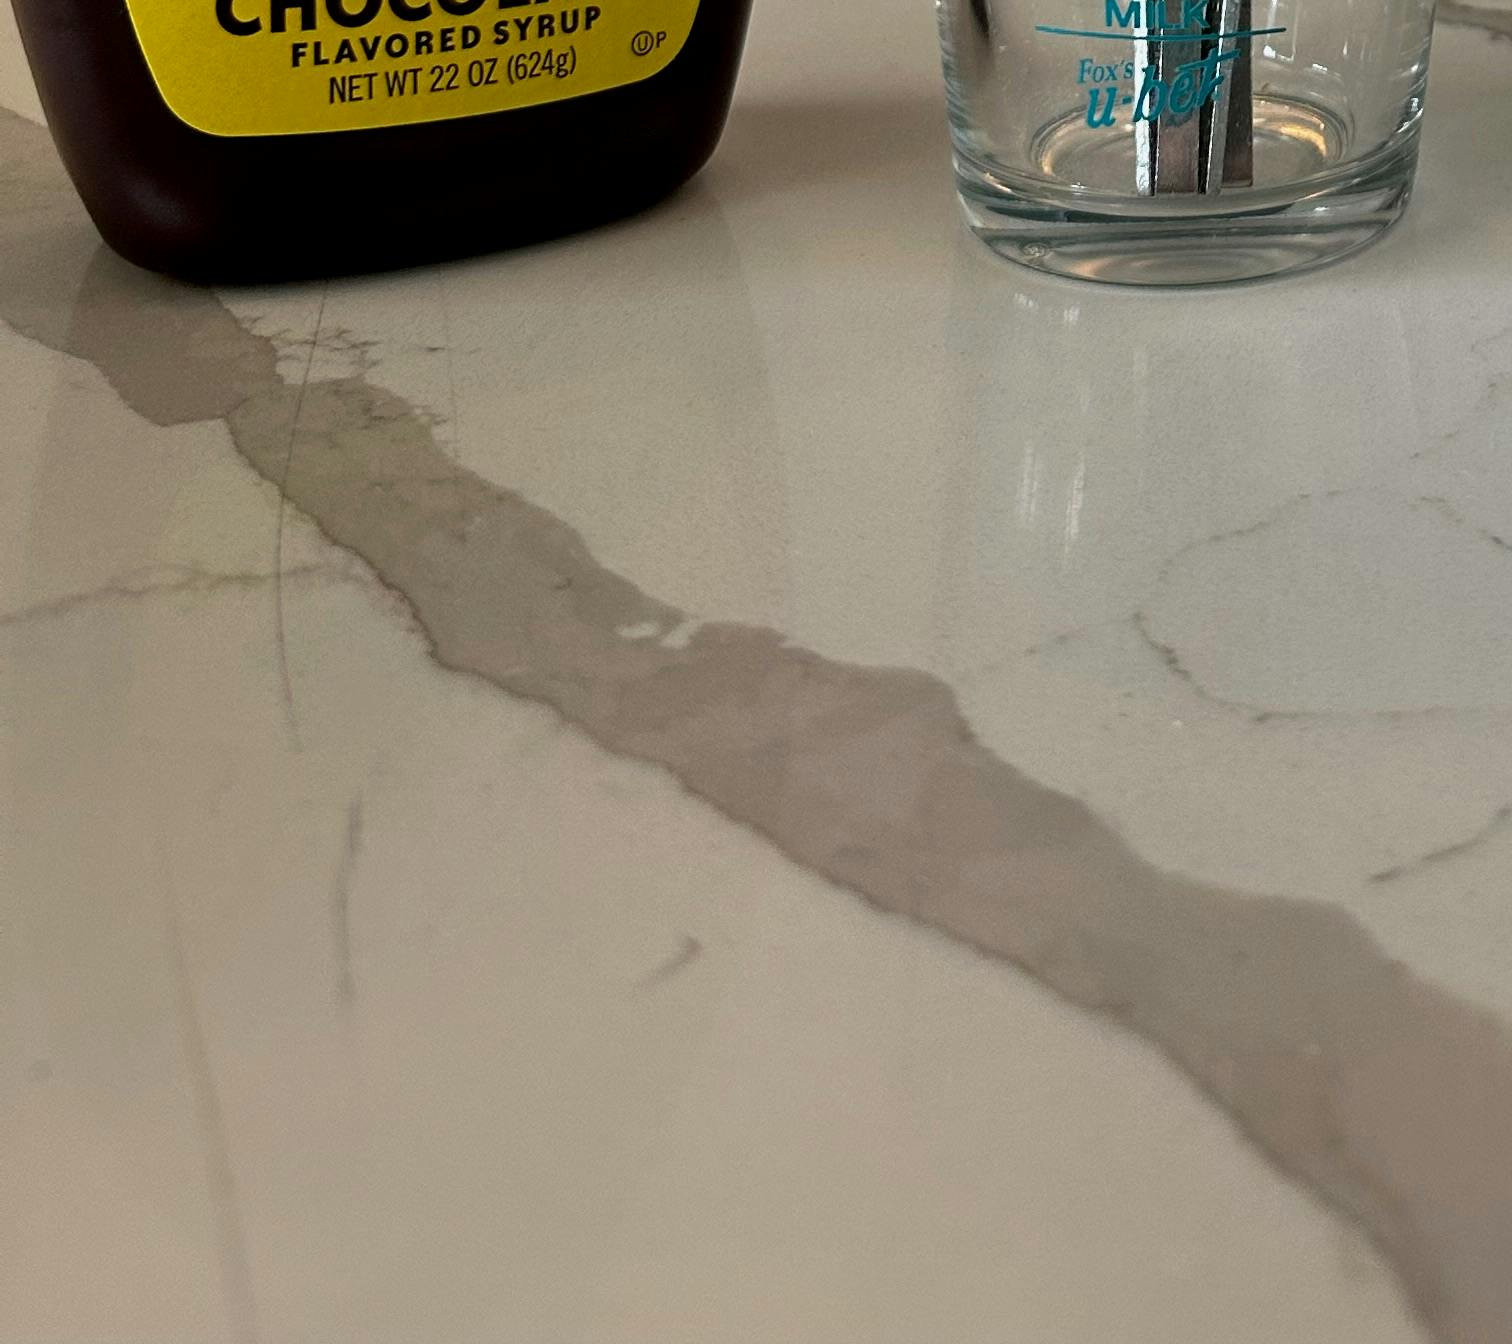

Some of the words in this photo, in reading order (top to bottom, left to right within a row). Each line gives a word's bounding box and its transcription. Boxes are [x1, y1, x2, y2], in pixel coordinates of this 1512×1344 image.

[292, 25, 481, 68] FLAVORED
[493, 6, 602, 46] SYRUP
[328, 72, 379, 105] NET
[384, 67, 424, 98] WT
[429, 63, 460, 93] 22
[468, 58, 499, 88] OZ
[507, 46, 578, 87] (624g)
[1077, 57, 1134, 85] Fox's
